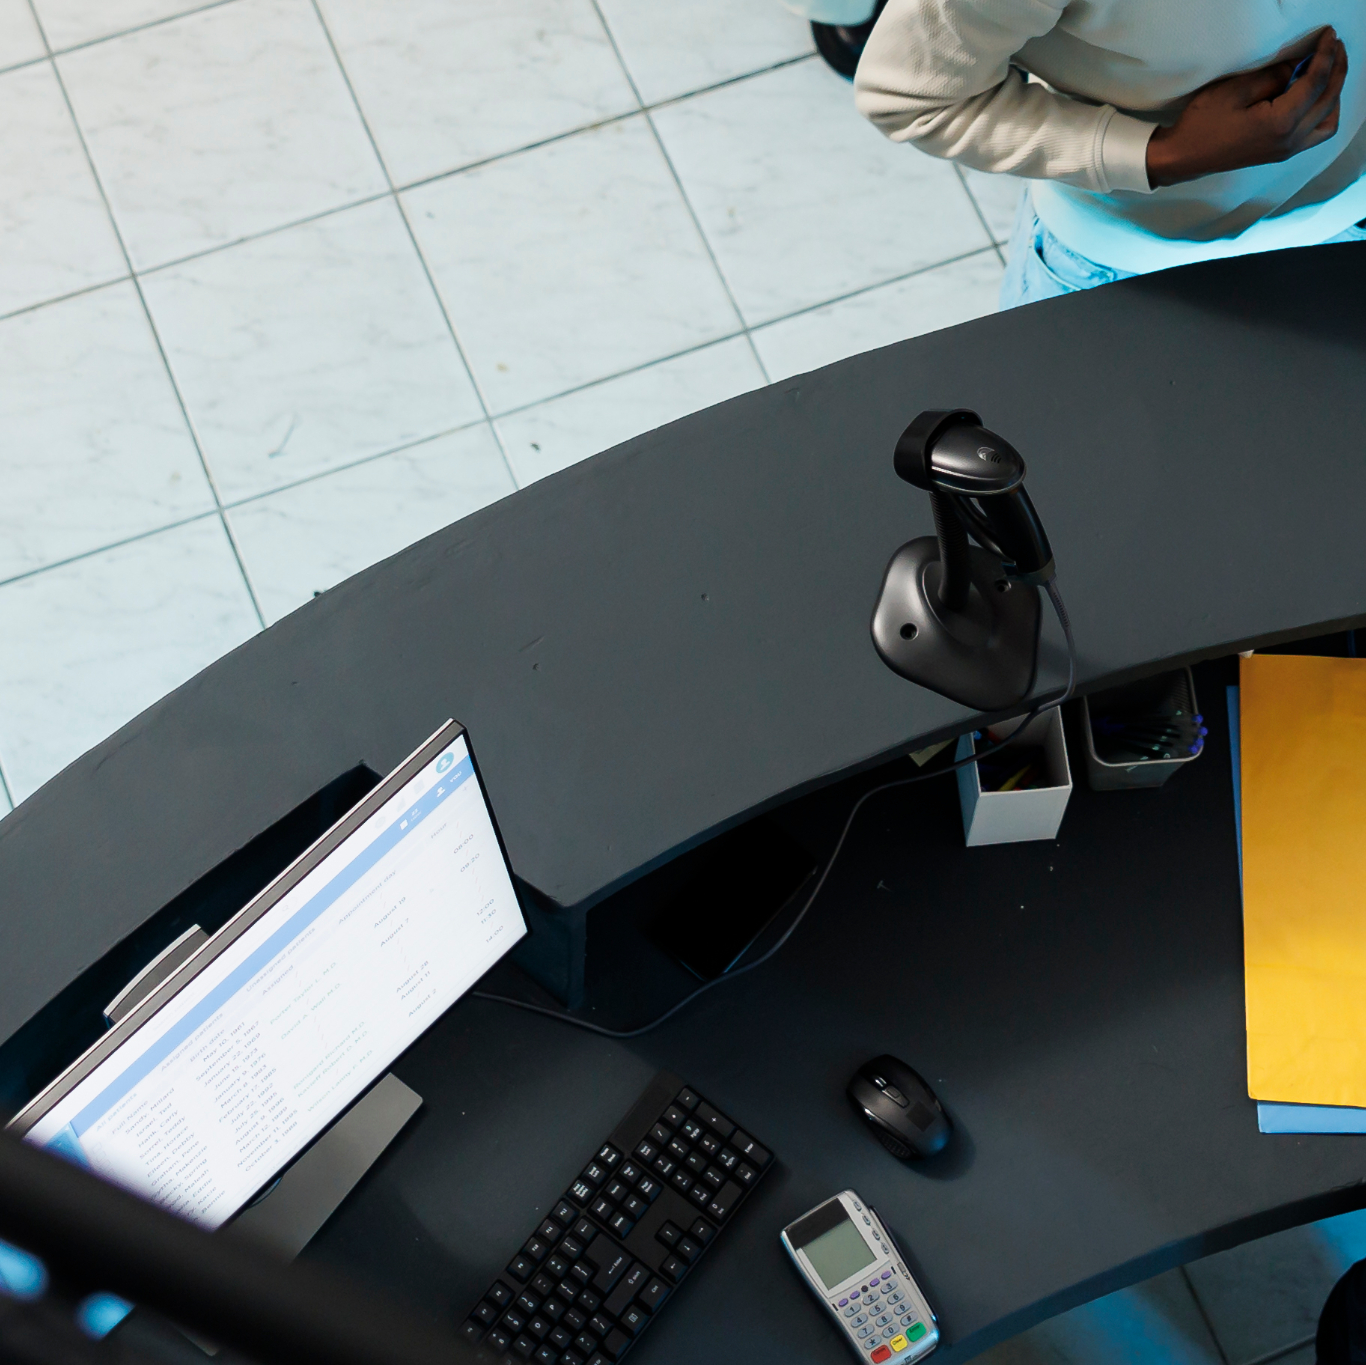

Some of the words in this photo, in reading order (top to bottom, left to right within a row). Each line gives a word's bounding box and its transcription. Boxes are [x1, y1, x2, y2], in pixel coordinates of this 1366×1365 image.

[430, 821, 447, 839] Hour
[337, 881, 382, 926] Appointment
[383, 868, 397, 884] day
[476, 897, 494, 917] 12:00
[373, 904, 397, 929] August
[379, 922, 404, 948] August
[246, 953, 286, 993] Unassigned
[286, 925, 316, 955] patients
[261, 963, 294, 996] Assigned
[395, 968, 419, 994] August
[399, 976, 423, 1001] August
[407, 993, 431, 1018] August
[160, 1038, 193, 1072] Assigned
[193, 1011, 223, 1041] patients
[189, 1042, 208, 1062] Birth
[208, 1027, 225, 1045] date
[202, 1046, 217, 1063] May
[195, 1043, 234, 1083] September
[202, 1059, 231, 1088] January
[213, 1072, 231, 1090] June
[95, 1119, 107, 1132] All
[107, 1091, 137, 1122] patients
[111, 1120, 126, 1135] Full
[126, 1098, 148, 1121] Name
[218, 1091, 250, 1124] February
[236, 1131, 272, 1168] November
[244, 1143, 273, 1172] October
